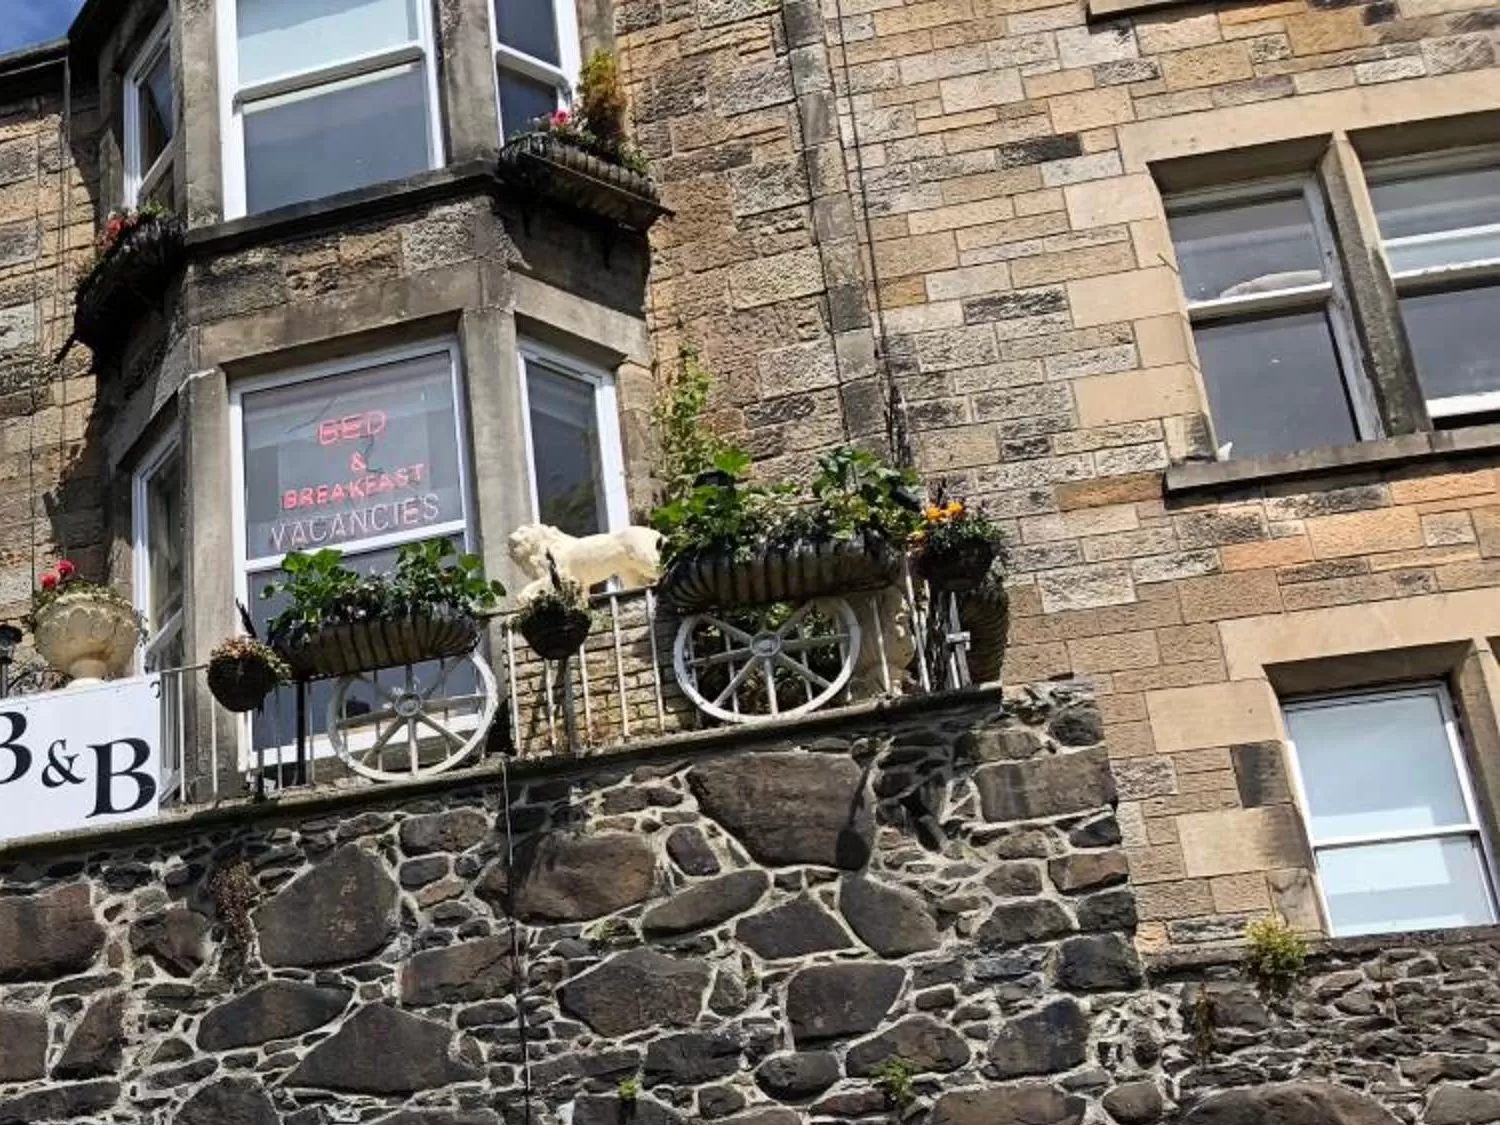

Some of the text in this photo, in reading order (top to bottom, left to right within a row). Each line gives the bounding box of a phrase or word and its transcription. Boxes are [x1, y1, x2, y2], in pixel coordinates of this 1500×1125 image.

[318, 410, 387, 445] BED
[351, 451, 367, 472] &
[282, 463, 424, 509] BREAKFAST
[271, 493, 440, 550] VACANCIES
